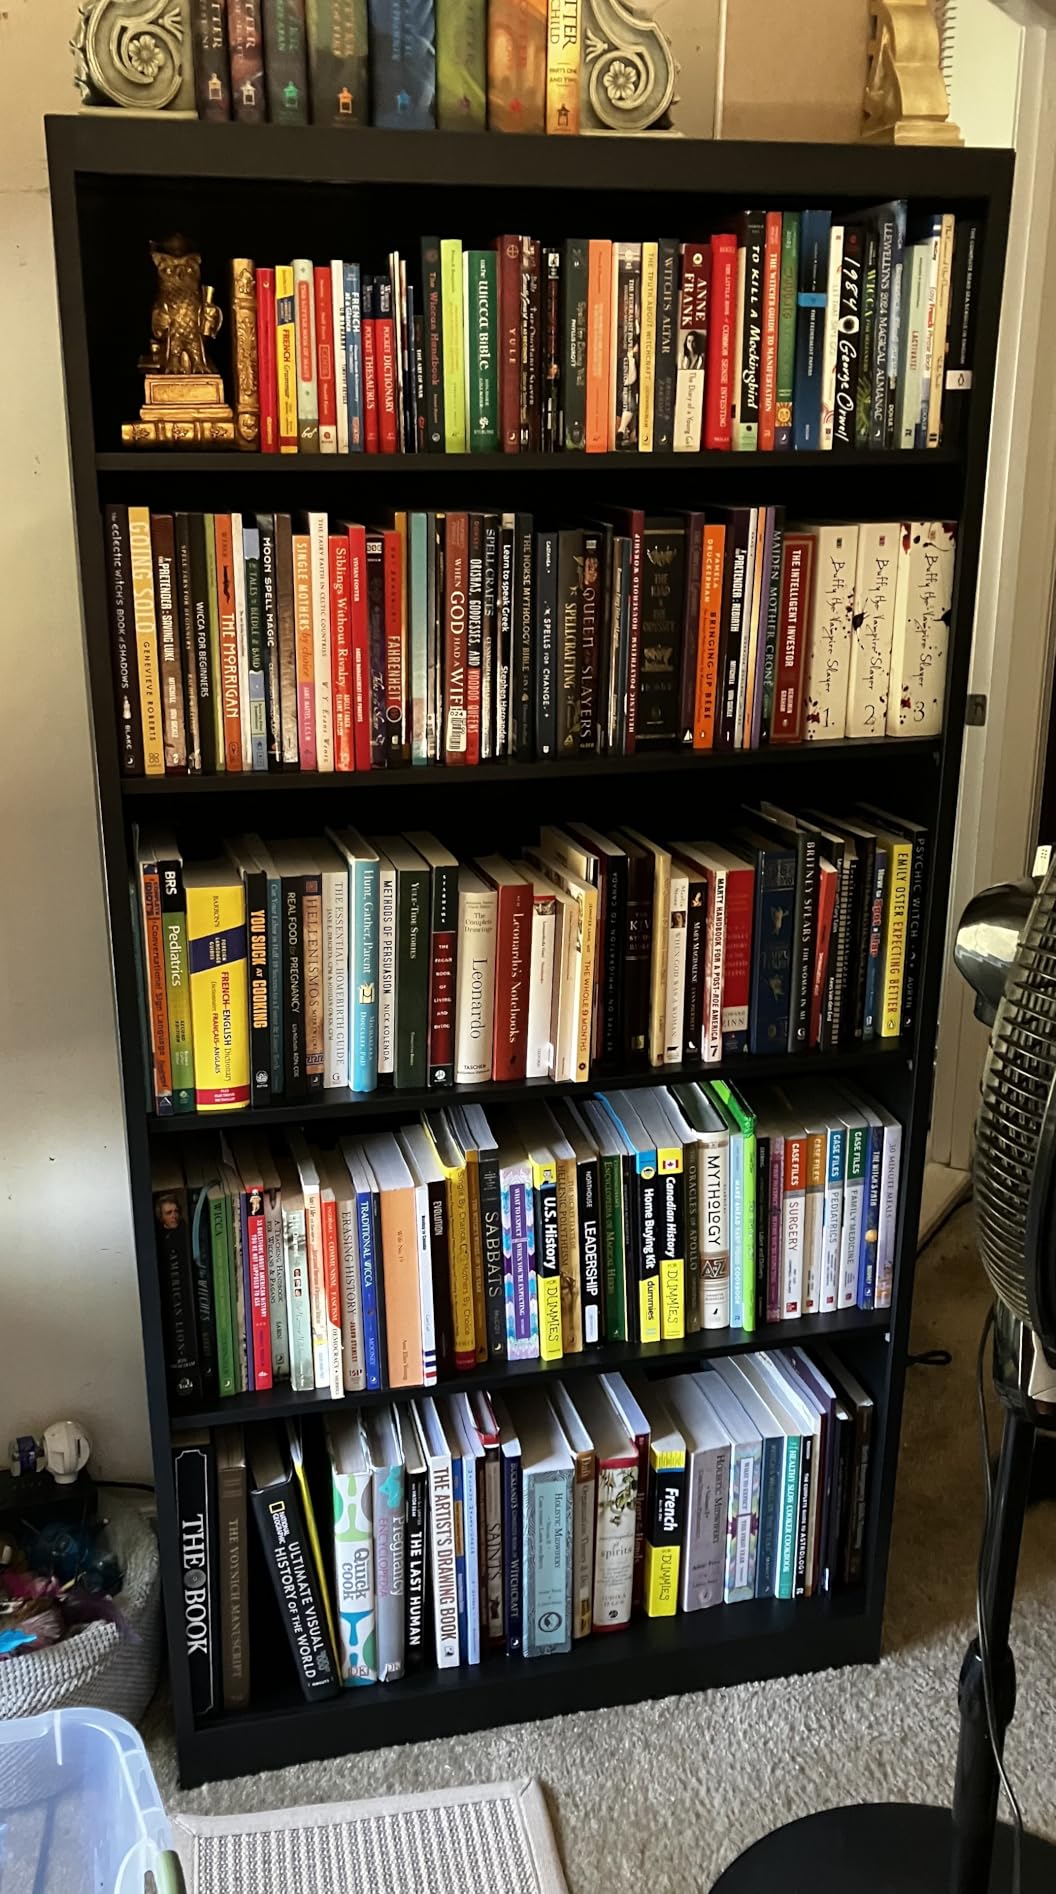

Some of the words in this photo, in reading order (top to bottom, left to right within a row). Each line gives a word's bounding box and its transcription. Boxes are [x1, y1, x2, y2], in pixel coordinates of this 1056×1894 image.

[752, 245, 760, 263] TO
[881, 223, 892, 289] LLEWELLYN'S
[682, 273, 694, 326] FRANK
[696, 279, 707, 321] ANNE
[751, 269, 759, 304] KILL
[843, 257, 861, 311] 1984
[880, 292, 888, 314] 2024
[352, 292, 360, 332] FRENCH
[430, 292, 438, 330] Wiccan
[750, 309, 759, 318] A
[431, 333, 439, 385] Handbook
[721, 324, 729, 356] COMMON
[876, 317, 887, 364] MAGICAL
[366, 356, 374, 409] THESAURUS
[688, 372, 696, 383] The
[743, 325, 761, 408] Mockingbird
[838, 340, 856, 389] George
[384, 355, 394, 413] DICTIONARY
[686, 385, 696, 401] Diary
[874, 368, 884, 421] ALMANAC
[682, 416, 691, 436] Young
[719, 387, 728, 428] INVESTING
[835, 392, 853, 442] Orwell
[263, 537, 272, 573] MOON
[503, 544, 511, 568] Learn
[523, 534, 531, 553] THE
[791, 550, 802, 566] THE
[334, 547, 347, 594] Siblings
[454, 558, 462, 587] WHEN
[502, 569, 510, 579] to
[523, 555, 531, 585] NORSE
[264, 577, 273, 611] SPELL
[450, 591, 464, 634] GOD
[501, 581, 510, 606] speak
[788, 568, 800, 623] INTELLIGENT
[196, 602, 206, 631] WICCA
[222, 613, 236, 639] THE
[266, 614, 274, 647] MAGIC
[336, 598, 348, 645] Without
[501, 607, 510, 632] Greek
[522, 587, 530, 644] MYTHOLOGY
[198, 632, 207, 649] FOR
[453, 638, 461, 657] HAD
[468, 650, 481, 666] AND
[563, 603, 577, 688] SPELLCRAFTING
[706, 612, 716, 668] BRINGING
[784, 625, 796, 667] INVESTOR
[143, 641, 152, 696] GENEVIEVE
[199, 651, 208, 698] BEGINNERS
[335, 648, 348, 687] Rivalry
[386, 636, 401, 701] FAHRENHEIT
[522, 647, 530, 672] BIBLE
[468, 670, 480, 700] VOODOO
[706, 674, 713, 687] UP
[146, 701, 156, 741] ROBERTS
[468, 705, 480, 733] QUEENS
[165, 871, 177, 895] BRS
[362, 870, 373, 899] Hunt,
[805, 841, 815, 894] BRITNEY
[896, 853, 908, 882] EMILY
[287, 892, 296, 915] REAL
[362, 902, 373, 940] Gather,
[383, 880, 393, 924] METHODS
[802, 899, 813, 943] SPEARS
[894, 887, 905, 917] OSTER
[251, 910, 265, 933] YOU
[288, 917, 297, 945] FOOD
[383, 926, 392, 938] OF
[714, 907, 723, 946] HANDBOOK
[168, 925, 182, 987] Pediatrics
[252, 936, 266, 965] SUCK
[362, 942, 372, 974] Parent
[511, 913, 524, 978] Leonardo's
[714, 948, 722, 962] FOR
[889, 921, 904, 975] EXPECTING
[255, 968, 263, 978] AT
[289, 957, 300, 1014] PREGNANCY
[382, 941, 392, 994] PERSUASION
[253, 980, 268, 1028] COOKING
[470, 959, 487, 1039] Leonardo
[712, 972, 721, 1008] POST-ROE
[887, 979, 900, 1013] BETTER
[383, 1004, 391, 1022] NICK
[509, 982, 522, 1043] Notebooks
[711, 1009, 720, 1041] AMERICA
[791, 1143, 799, 1165] CASE
[854, 1132, 862, 1151] CASE
[790, 1166, 798, 1185] FILES
[832, 1155, 840, 1177] FILES
[852, 1153, 861, 1174] FILES
[544, 1197, 556, 1222] U.S.
[644, 1188, 654, 1218] Home
[665, 1177, 676, 1222] Canadian
[707, 1155, 721, 1246] MYTHOLOGY
[829, 1192, 838, 1244] PEDIATRICS
[341, 1211, 354, 1262] ERASING
[361, 1201, 371, 1258] TRADITIONAL
[642, 1219, 655, 1254] Buying
[665, 1223, 677, 1257] History
[788, 1202, 798, 1251] SURGERY
[485, 1212, 502, 1298] SABBATS
[543, 1224, 558, 1269] History
[584, 1221, 598, 1296] LEADERSHIP
[645, 1255, 656, 1269] Kit
[344, 1266, 357, 1314] HISTORY
[364, 1261, 373, 1287] WICCA
[546, 1288, 559, 1342] DUMMIES
[646, 1281, 656, 1320] dummies
[667, 1270, 679, 1323] DUMMIES
[433, 1467, 449, 1491] THE
[435, 1494, 451, 1547] ARTIST'S
[663, 1488, 679, 1531] French
[182, 1514, 204, 1570] THE
[228, 1519, 239, 1543] THE
[410, 1531, 423, 1559] THE
[229, 1549, 240, 1600] VOYNICH
[274, 1547, 297, 1601] HISTORY
[342, 1562, 354, 1600] cook
[354, 1547, 369, 1600] Quick
[410, 1561, 422, 1593] LAST
[437, 1550, 453, 1605] DRAWING
[659, 1555, 672, 1600] DUMMIES
[288, 1542, 312, 1605] ULTIMATE
[304, 1607, 324, 1652] VISUAL
[288, 1601, 298, 1614] OF
[184, 1589, 207, 1655] BOOK
[291, 1616, 303, 1635] THE
[409, 1596, 421, 1645] HUMAN
[440, 1608, 456, 1642] BOOK
[231, 1603, 243, 1679] MANUSCRIPT
[297, 1636, 316, 1679] WORLD
